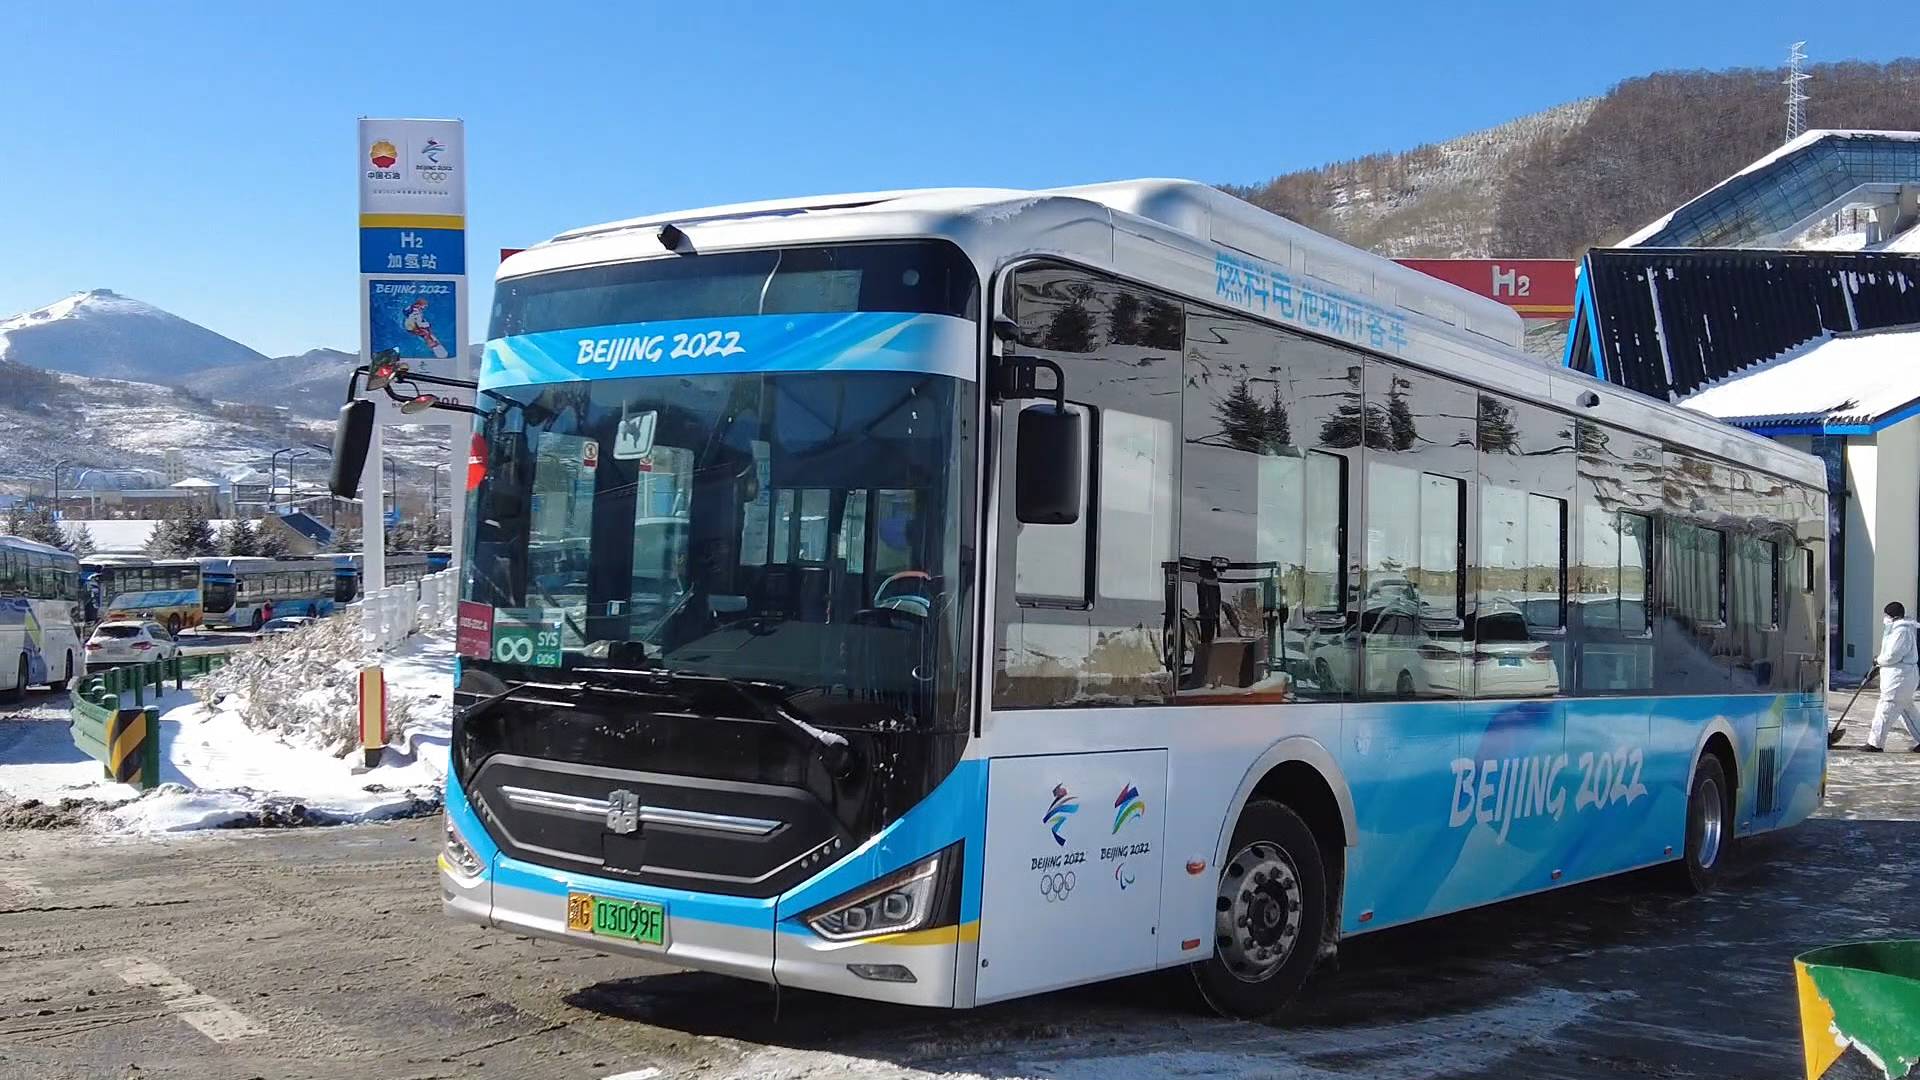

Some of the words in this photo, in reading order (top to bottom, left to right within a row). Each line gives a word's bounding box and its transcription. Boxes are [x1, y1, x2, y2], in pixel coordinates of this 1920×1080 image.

[367, 171, 401, 180] 中国石油
[400, 231, 424, 248] H2
[386, 252, 438, 270] 加氢站
[375, 283, 417, 296] BEIJING
[418, 285, 451, 295] 2022
[1492, 264, 1530, 297] H2
[576, 334, 665, 371] BEIJING
[670, 330, 747, 359] 2022
[536, 631, 560, 647] SYS
[1448, 752, 1569, 845] BEIJING
[1574, 748, 1649, 813] 2022
[1031, 855, 1062, 872] BEIJING
[1063, 851, 1087, 866] 2022
[1100, 845, 1129, 862] BEIJING
[1129, 842, 1152, 856] 2022
